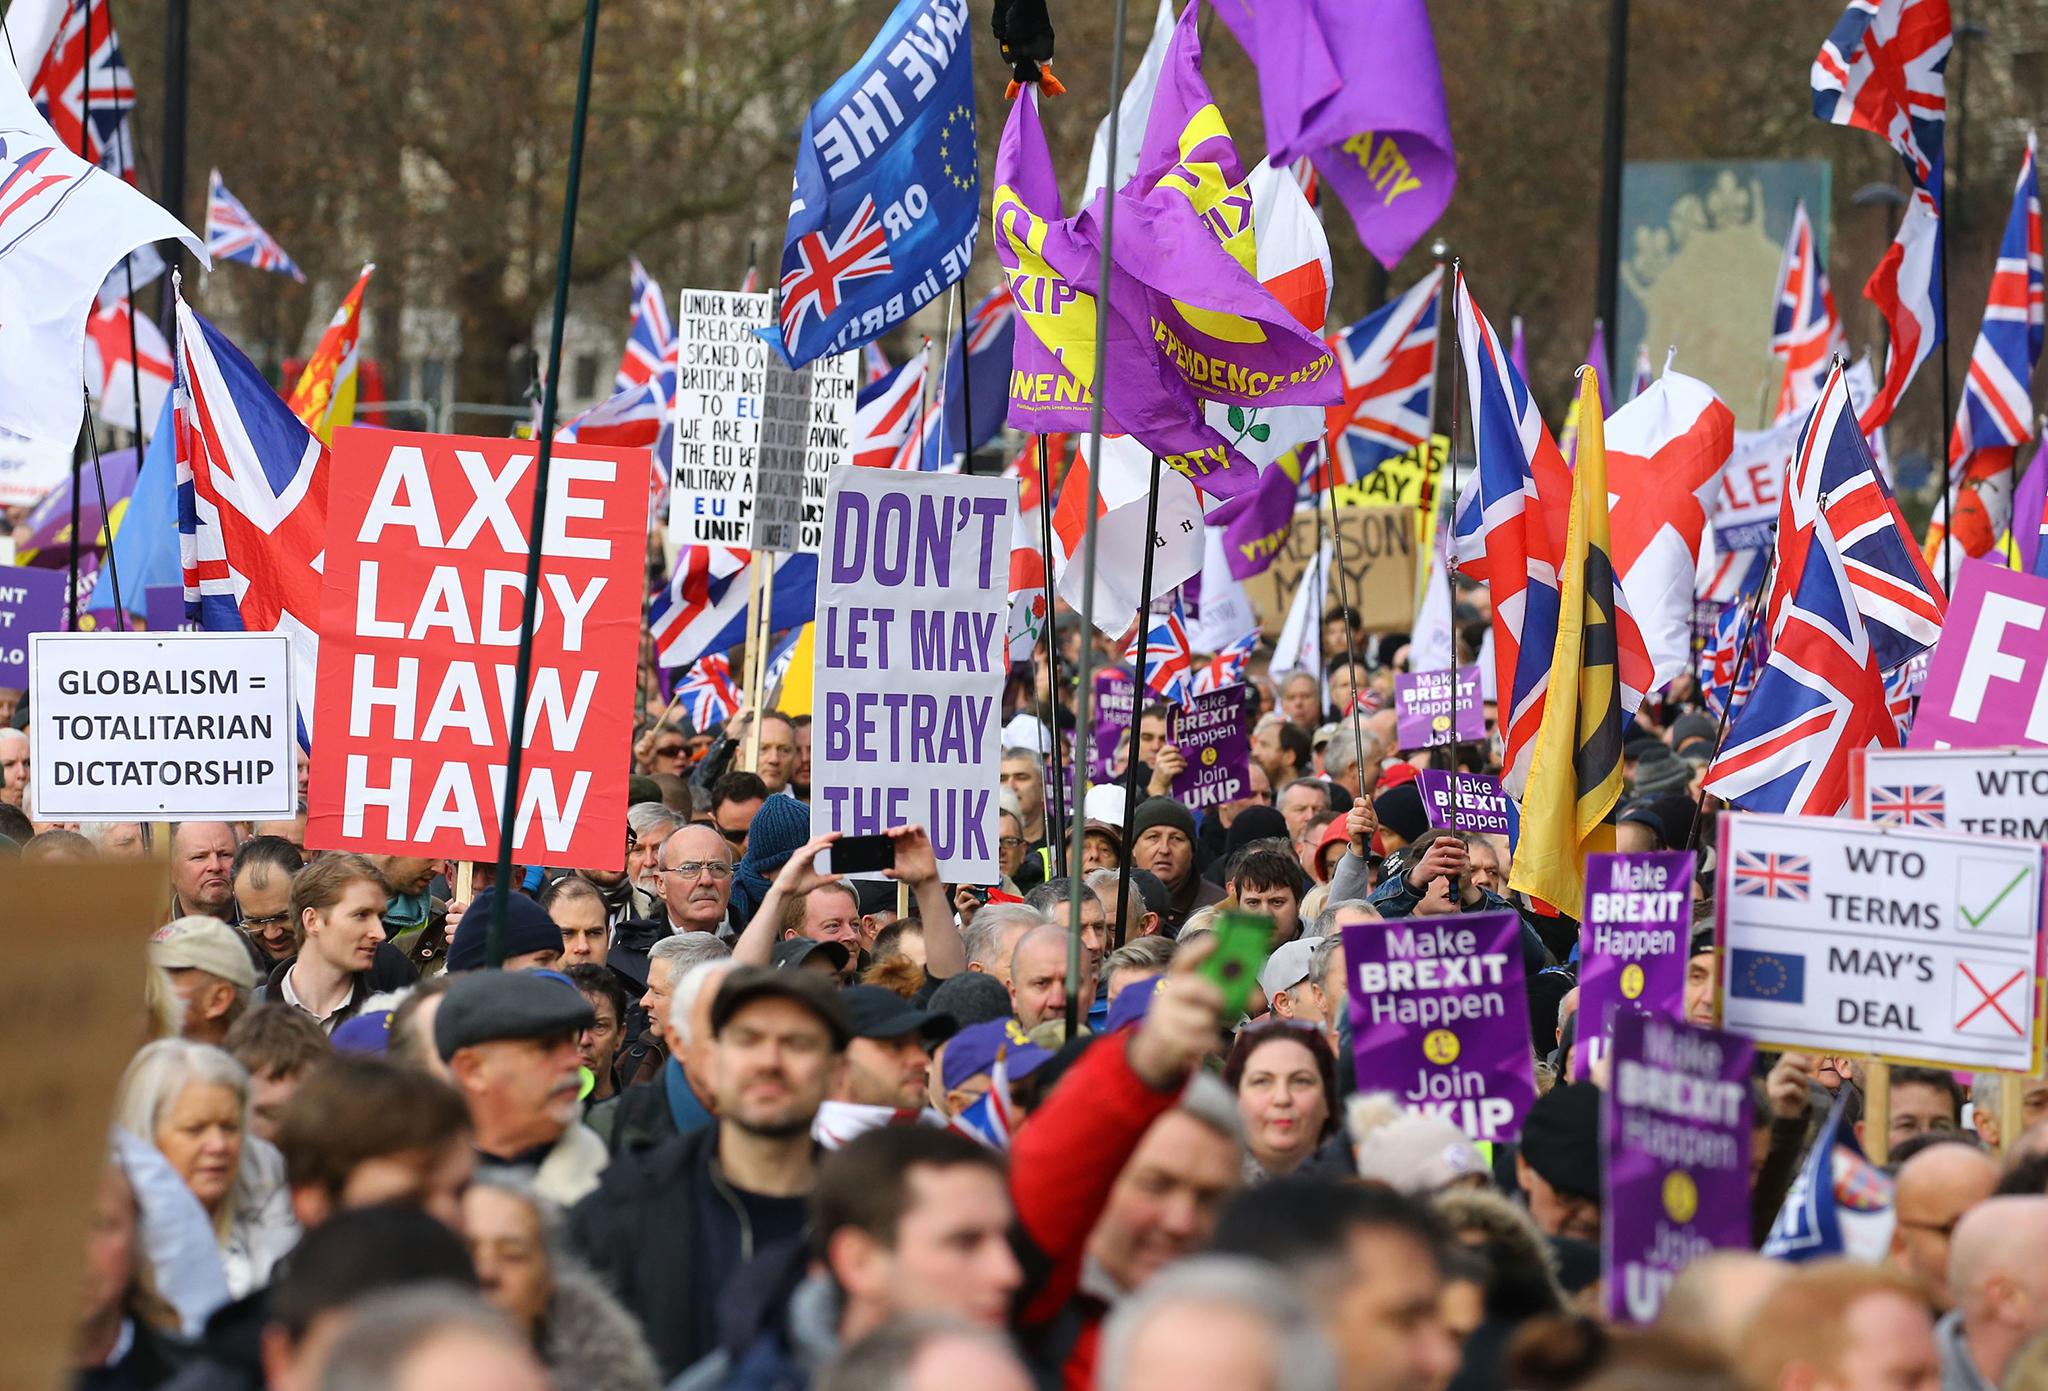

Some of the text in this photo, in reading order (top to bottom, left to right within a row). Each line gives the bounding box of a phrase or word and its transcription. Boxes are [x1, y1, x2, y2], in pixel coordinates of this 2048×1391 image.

[1343, 130, 1422, 207] ARTY
[684, 295, 768, 319] UNDER BREX
[1006, 272, 1077, 316] KIP
[687, 343, 739, 369] SIGNED
[1151, 316, 1286, 398] EPENDENCE
[682, 366, 735, 392] BRITISH
[814, 377, 854, 400] YSTEM
[701, 395, 722, 416] TO
[814, 401, 839, 424] ROL
[680, 419, 702, 439] WE
[713, 421, 742, 443] ARE
[808, 427, 849, 449] AVING
[680, 443, 707, 466] THE
[714, 447, 732, 466] EU
[1165, 444, 1231, 478] RTY
[675, 468, 736, 492] MILITARY
[356, 445, 617, 561] AXE
[694, 497, 725, 517] EU
[831, 490, 1007, 590] DON'T
[355, 560, 608, 652] LADY
[825, 606, 998, 673] LET MAY
[58, 669, 238, 696] GLOBALISM
[349, 653, 600, 752] HAW
[1176, 704, 1241, 735] BREXIT
[52, 714, 272, 741] TOTALITARIAN
[825, 691, 993, 764] BETRAY
[1177, 722, 1238, 750] Happen
[54, 760, 274, 787] DICTATORSHIP
[1193, 764, 1229, 787] Join
[341, 753, 594, 854] HAW
[1183, 778, 1242, 810] UKIP
[929, 788, 990, 862] UK
[1610, 860, 1668, 892] Make
[1845, 846, 1926, 880] WTO
[1590, 891, 1685, 924] BREXIT
[1825, 893, 1941, 931] TERMS
[1384, 925, 1478, 960] Make
[1594, 925, 1677, 962] Happen
[1358, 952, 1509, 994] BREXIT
[1829, 947, 1935, 983] MAY'S
[1370, 991, 1505, 1029] Happen
[1837, 998, 1922, 1032] DEAL
[1405, 1066, 1486, 1101] Join
